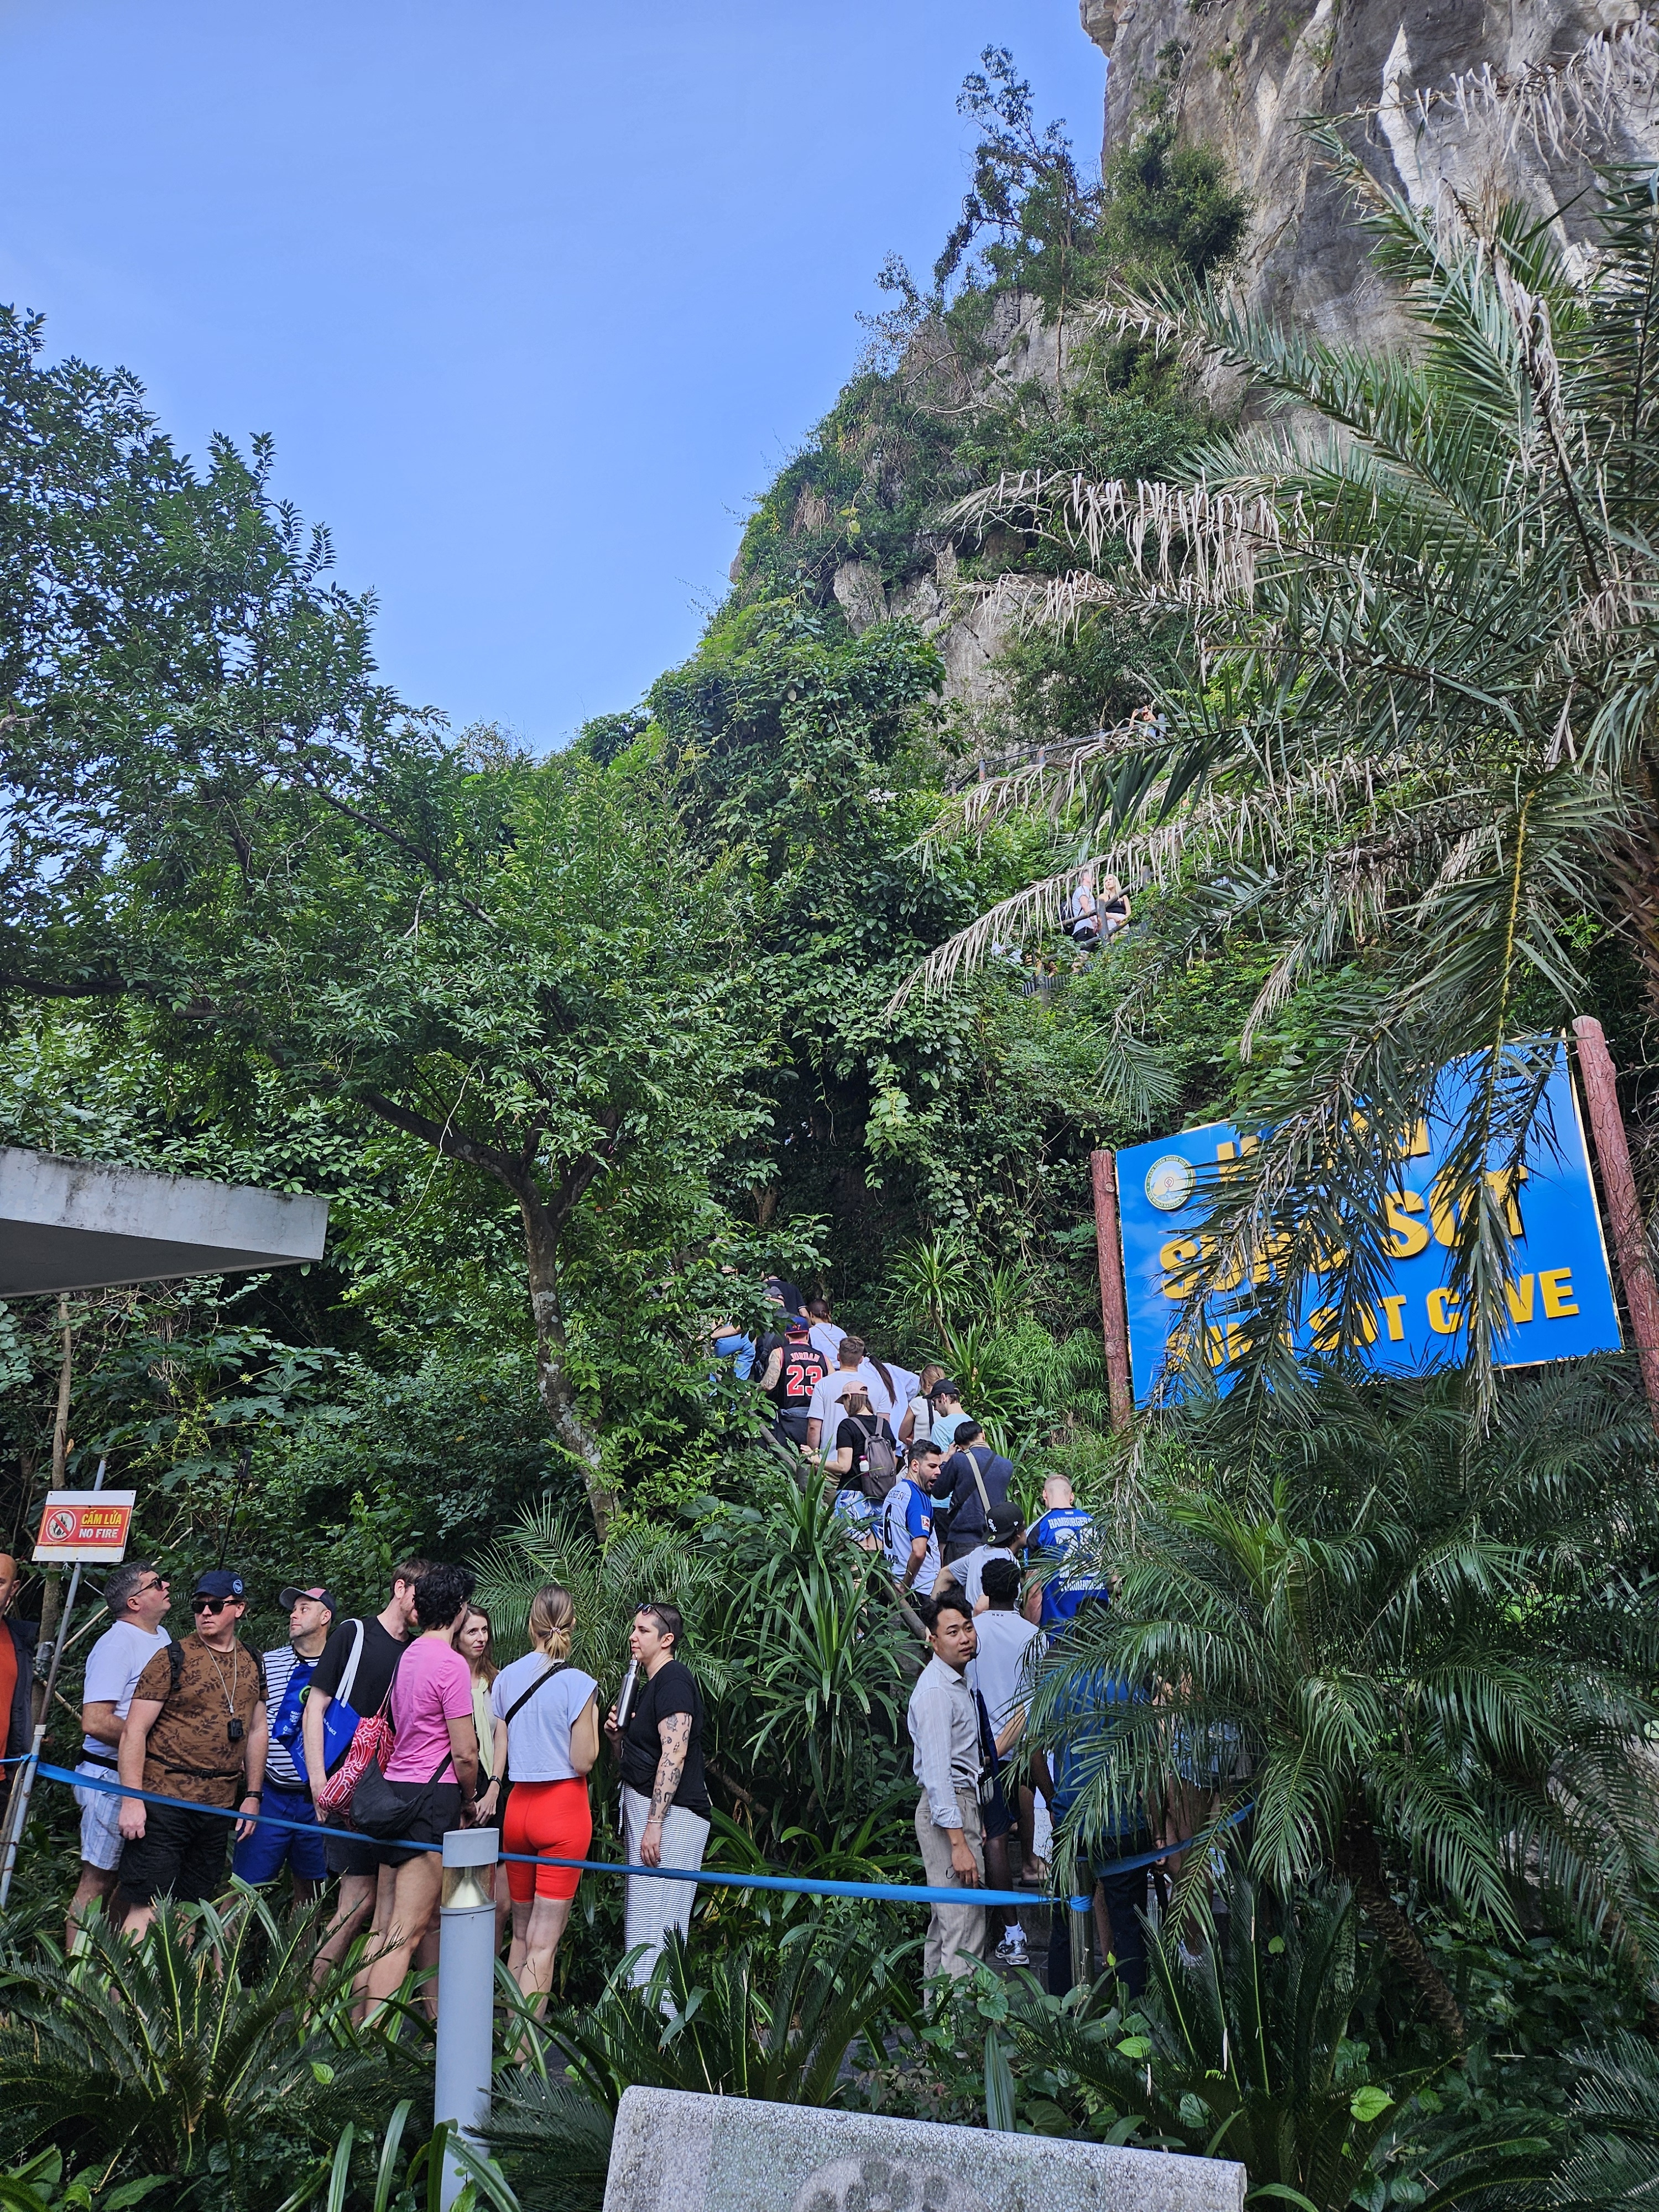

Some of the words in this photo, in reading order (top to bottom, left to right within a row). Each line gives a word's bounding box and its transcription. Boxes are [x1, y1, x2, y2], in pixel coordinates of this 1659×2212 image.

[1427, 1267, 1579, 1334] CVE
[790, 1352, 820, 1363] JORDAN
[786, 1365, 823, 1397] 23
[82, 1510, 102, 1525] CẤM
[104, 1510, 122, 1525] LỬA
[79, 1528, 93, 1538] NO
[95, 1528, 119, 1538] FIRE
